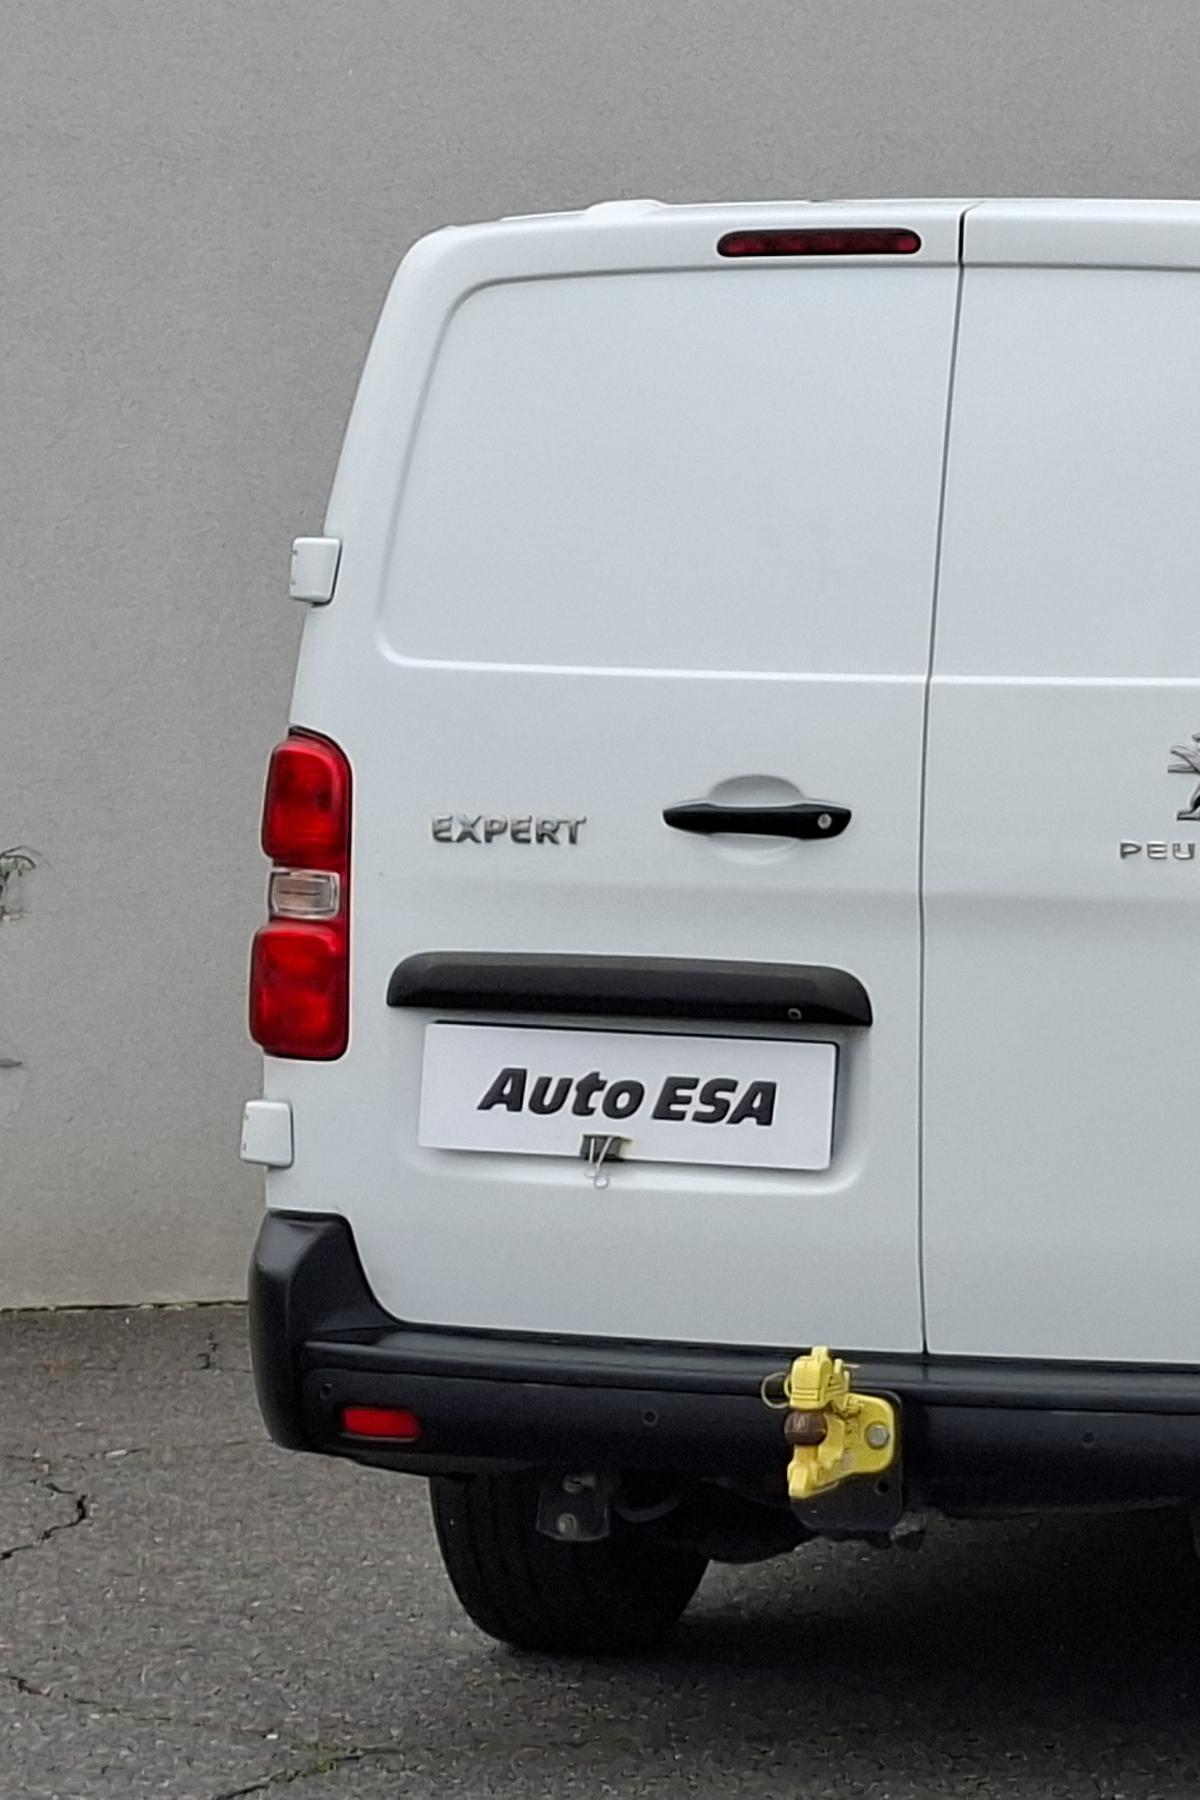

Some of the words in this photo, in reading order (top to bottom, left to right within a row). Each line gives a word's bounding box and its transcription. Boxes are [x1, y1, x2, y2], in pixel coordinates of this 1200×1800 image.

[431, 814, 587, 845] EXPERT
[476, 1067, 645, 1119] Auto
[650, 1075, 777, 1127] ESA
